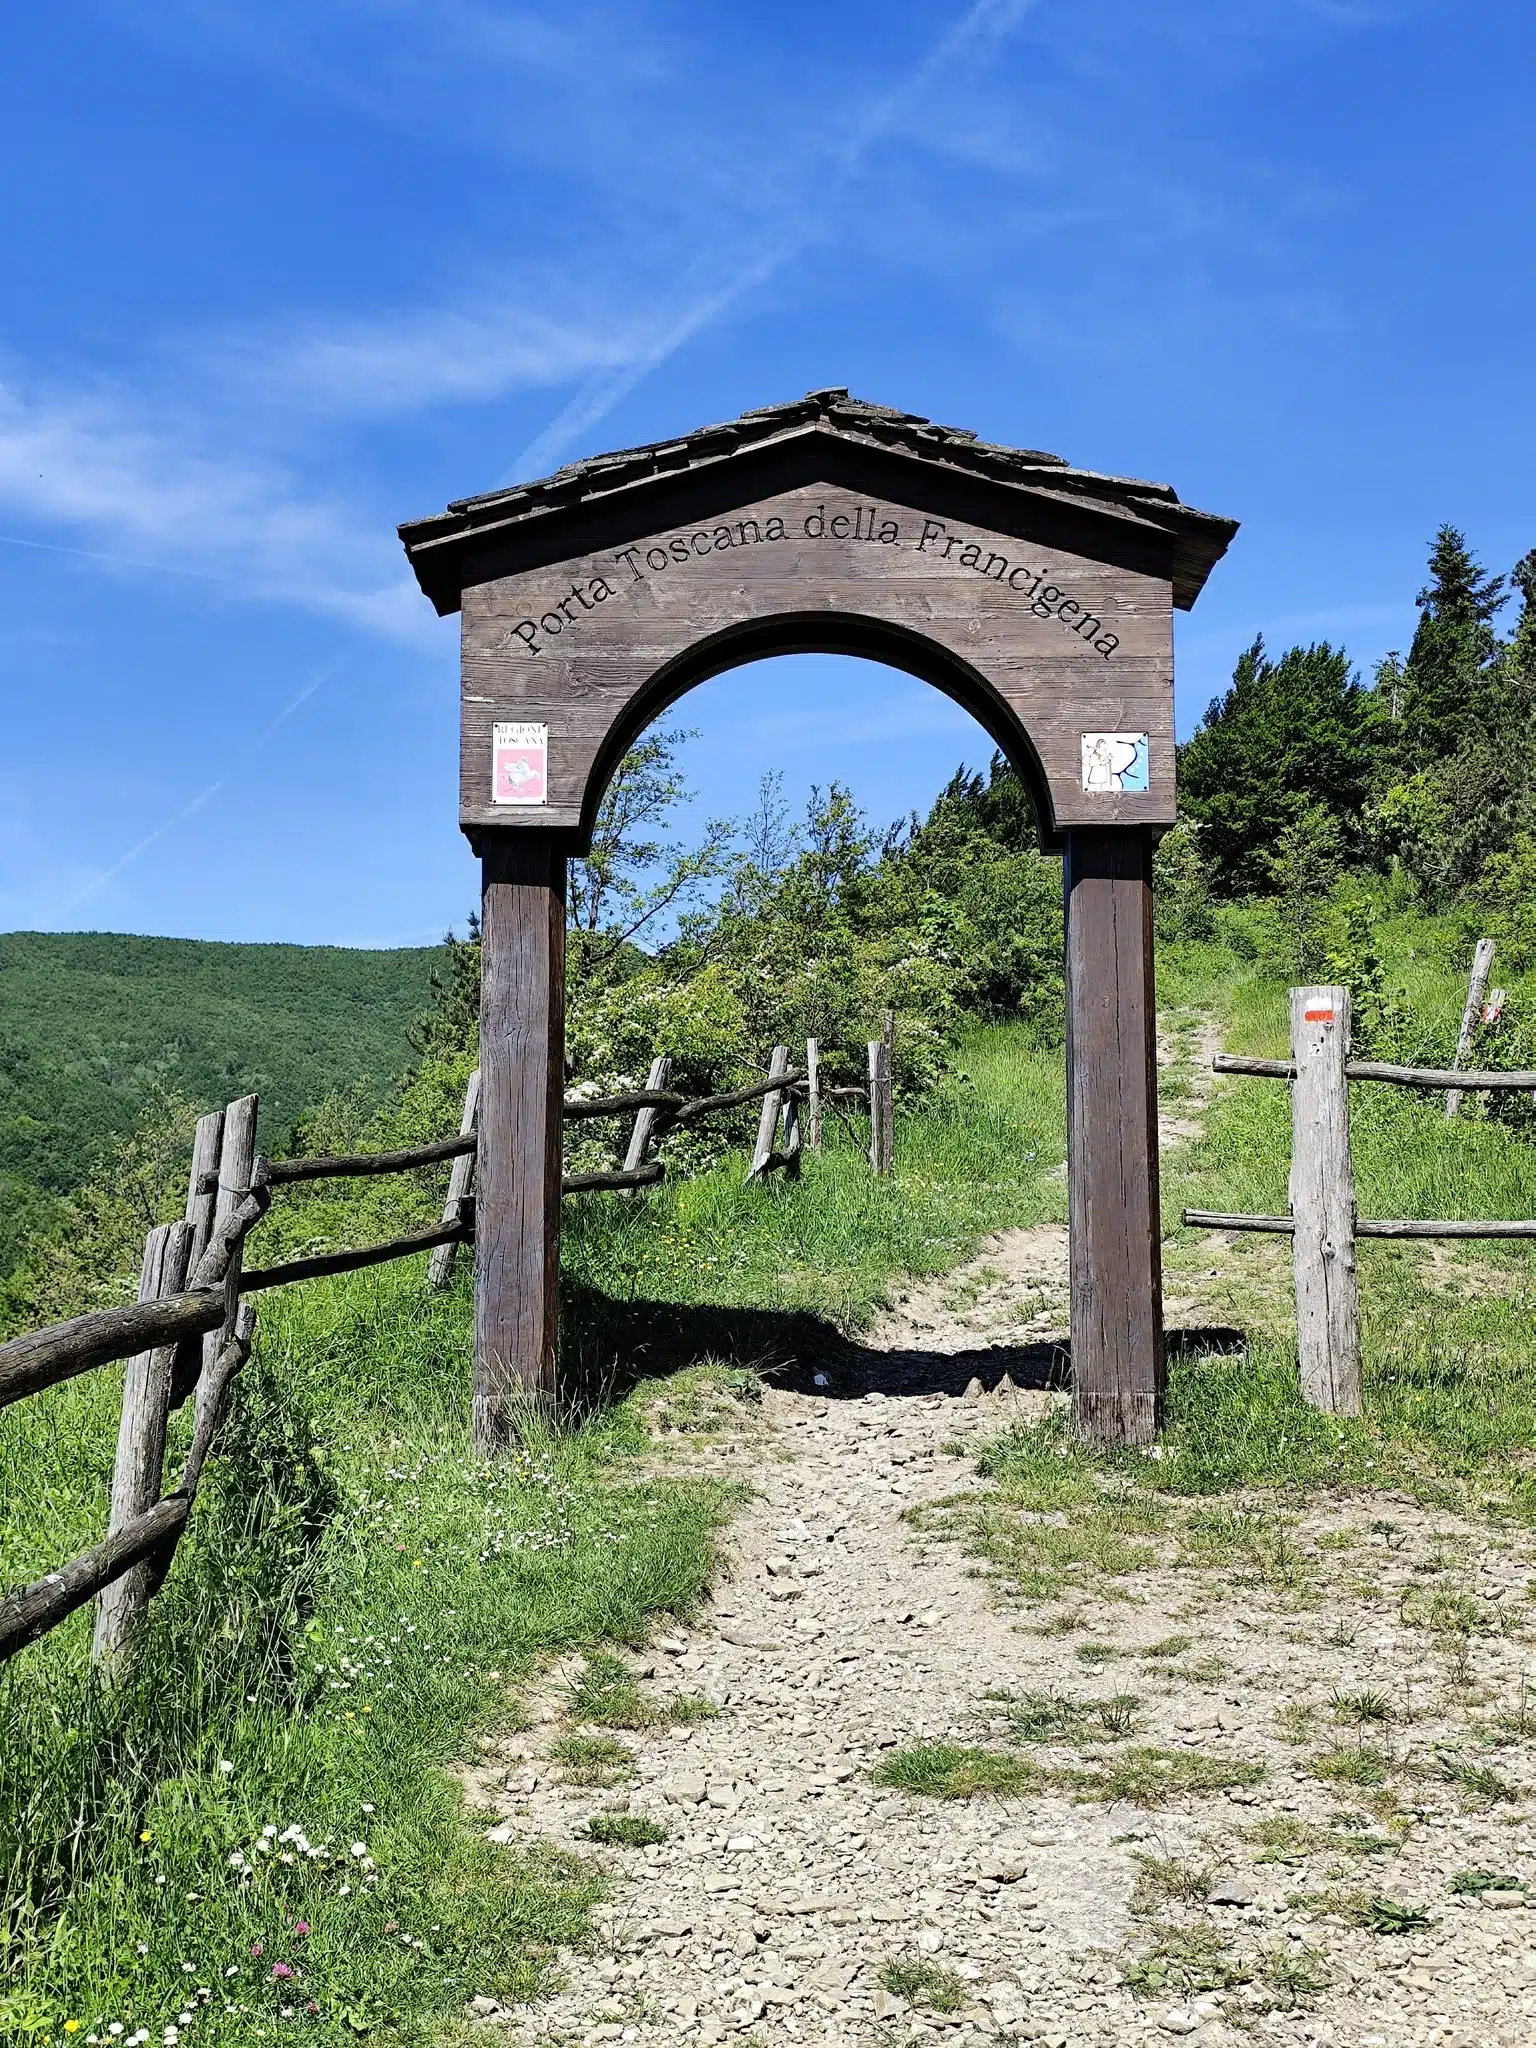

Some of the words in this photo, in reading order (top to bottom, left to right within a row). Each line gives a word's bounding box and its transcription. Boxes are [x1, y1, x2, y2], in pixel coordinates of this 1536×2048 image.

[510, 577, 617, 656] Porta
[614, 517, 790, 582] Toscana
[803, 504, 901, 547] della
[914, 518, 1120, 661] Francigena
